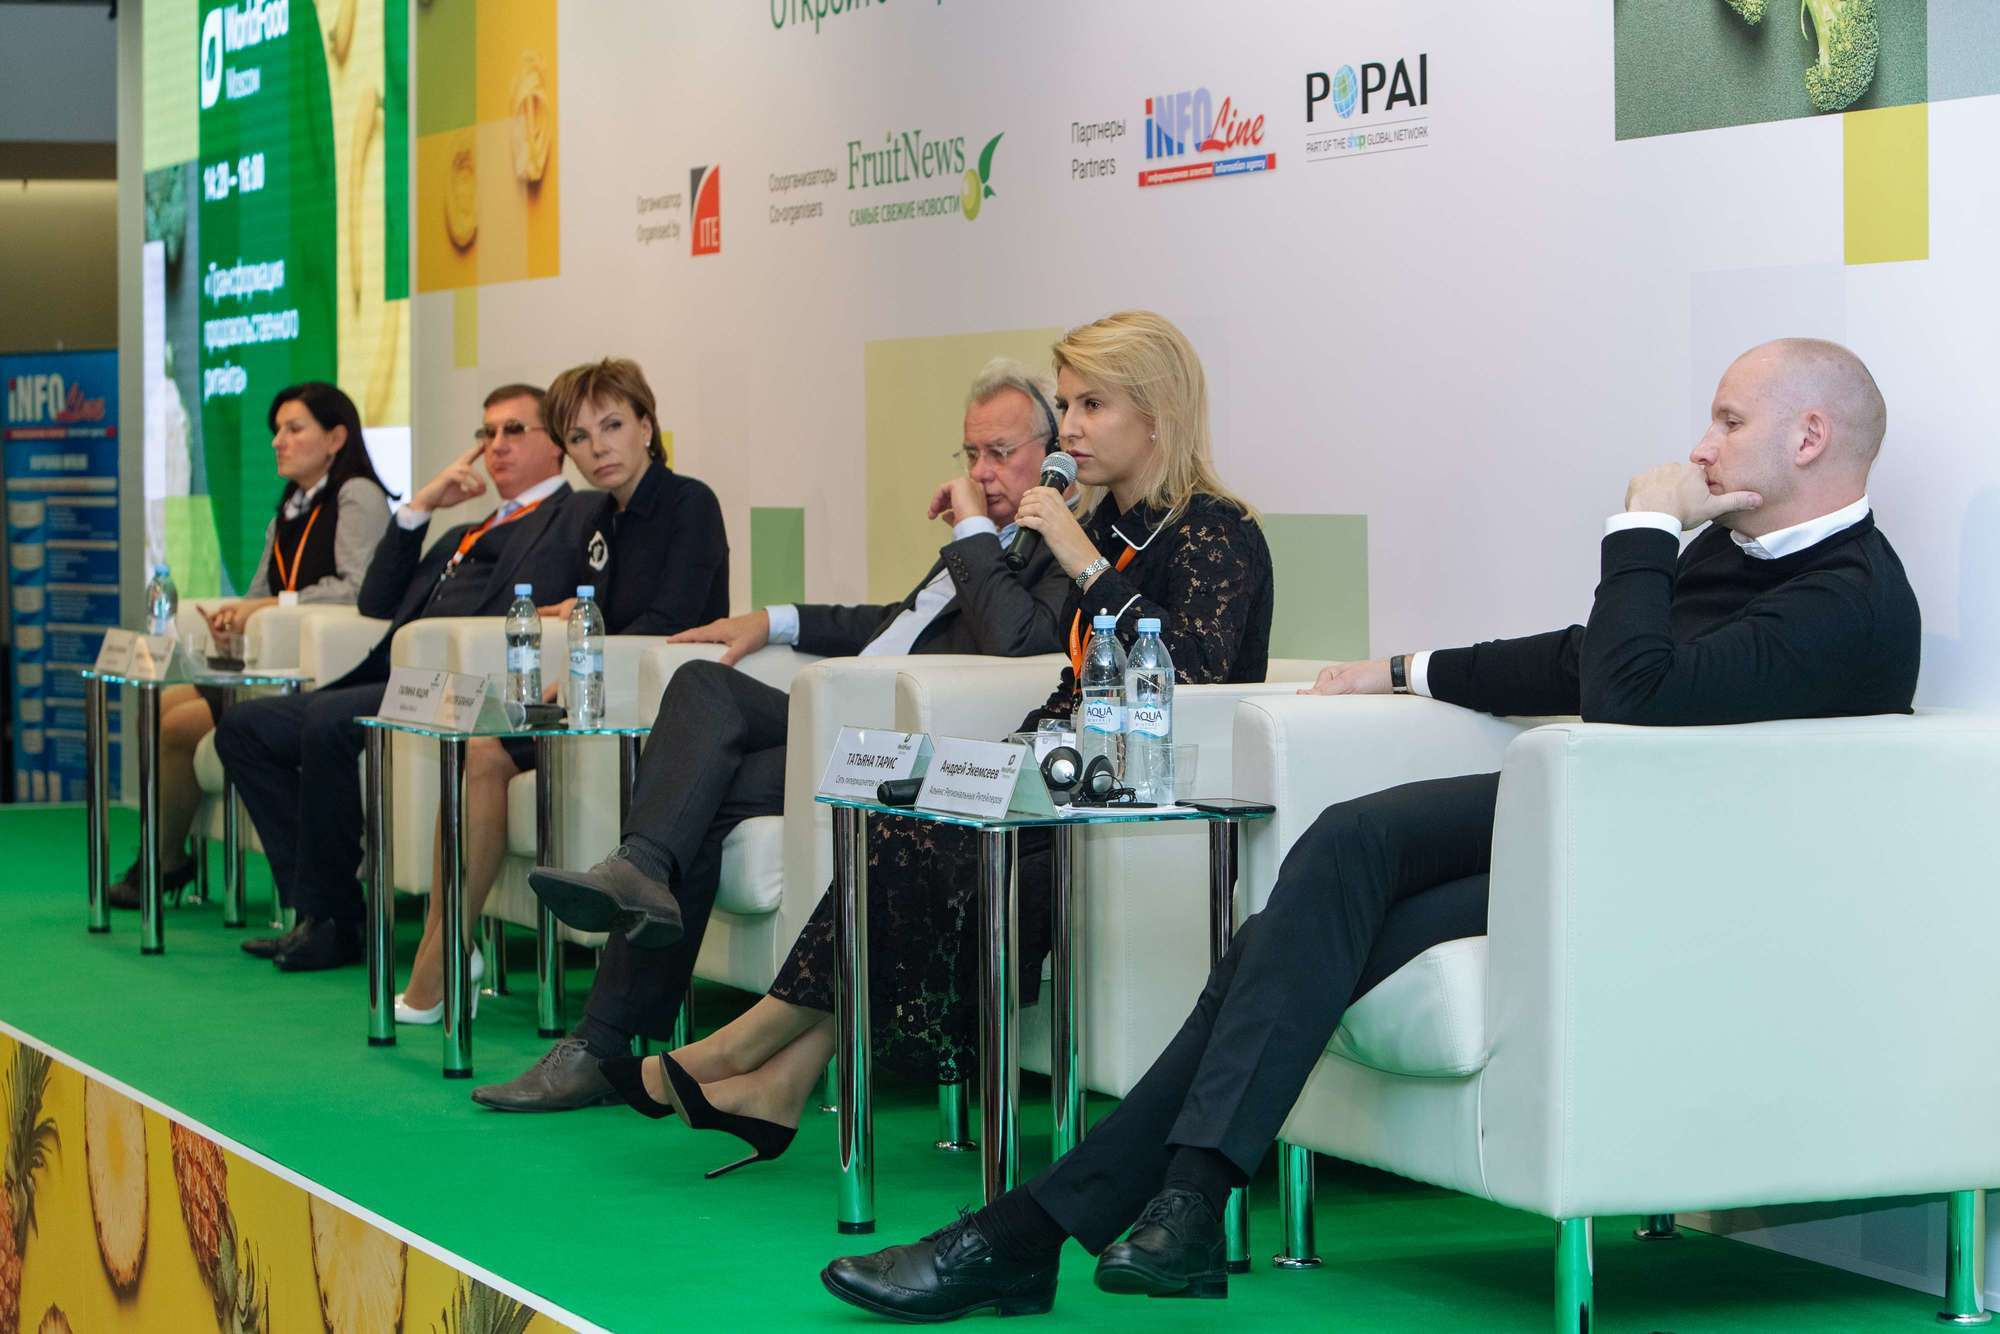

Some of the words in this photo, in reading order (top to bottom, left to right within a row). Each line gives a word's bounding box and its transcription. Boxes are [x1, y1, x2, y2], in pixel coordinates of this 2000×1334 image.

[1306, 54, 1428, 122] POPAI
[1071, 119, 1127, 147] Партнеры
[848, 130, 966, 190] FruitNews
[1071, 154, 1117, 183] Partners
[1086, 706, 1113, 719] AQUA
[1134, 710, 1163, 723] AQUA
[846, 752, 874, 768] ТАТЬЯНА
[874, 755, 898, 770] ТАРИС
[940, 759, 966, 777] Андрей
